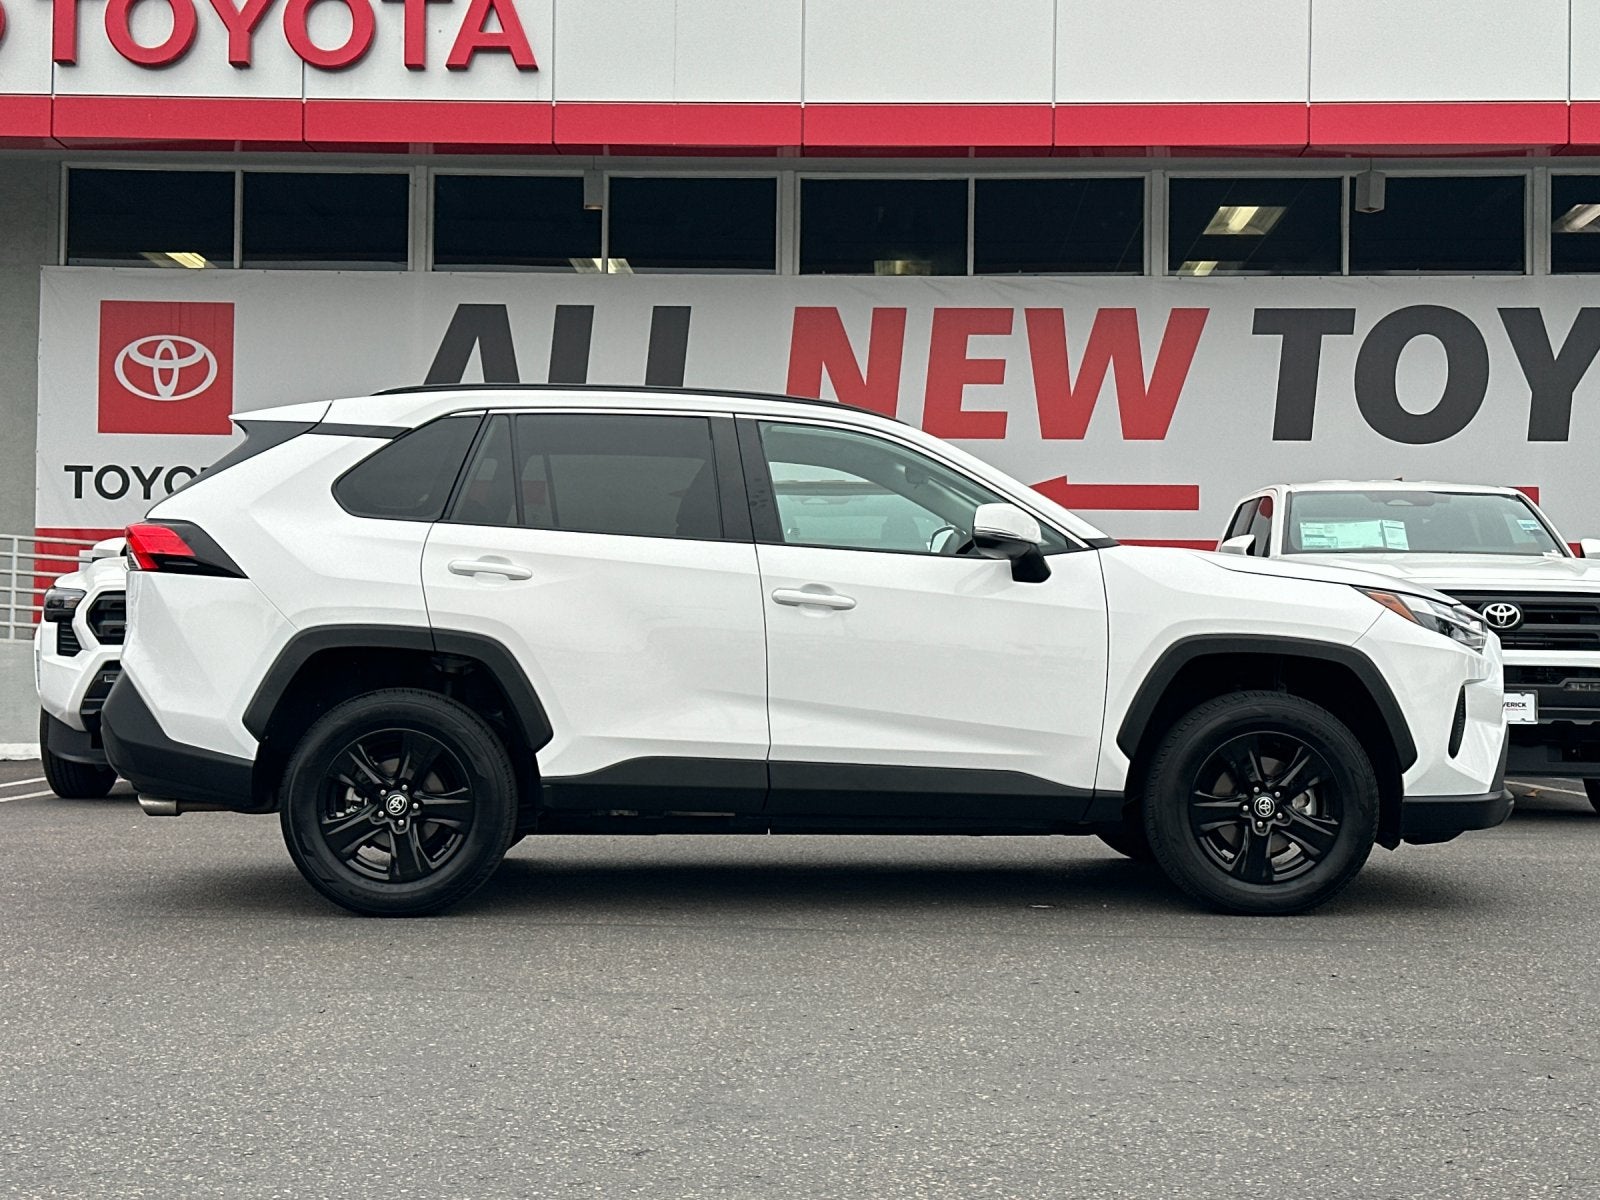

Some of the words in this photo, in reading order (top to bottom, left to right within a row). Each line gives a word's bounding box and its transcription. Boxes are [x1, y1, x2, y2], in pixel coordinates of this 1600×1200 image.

[53, 0, 539, 71] TOYOTA
[786, 306, 1210, 440] NEW
[1252, 304, 1600, 445] TOY
[64, 464, 209, 500] TOYO
